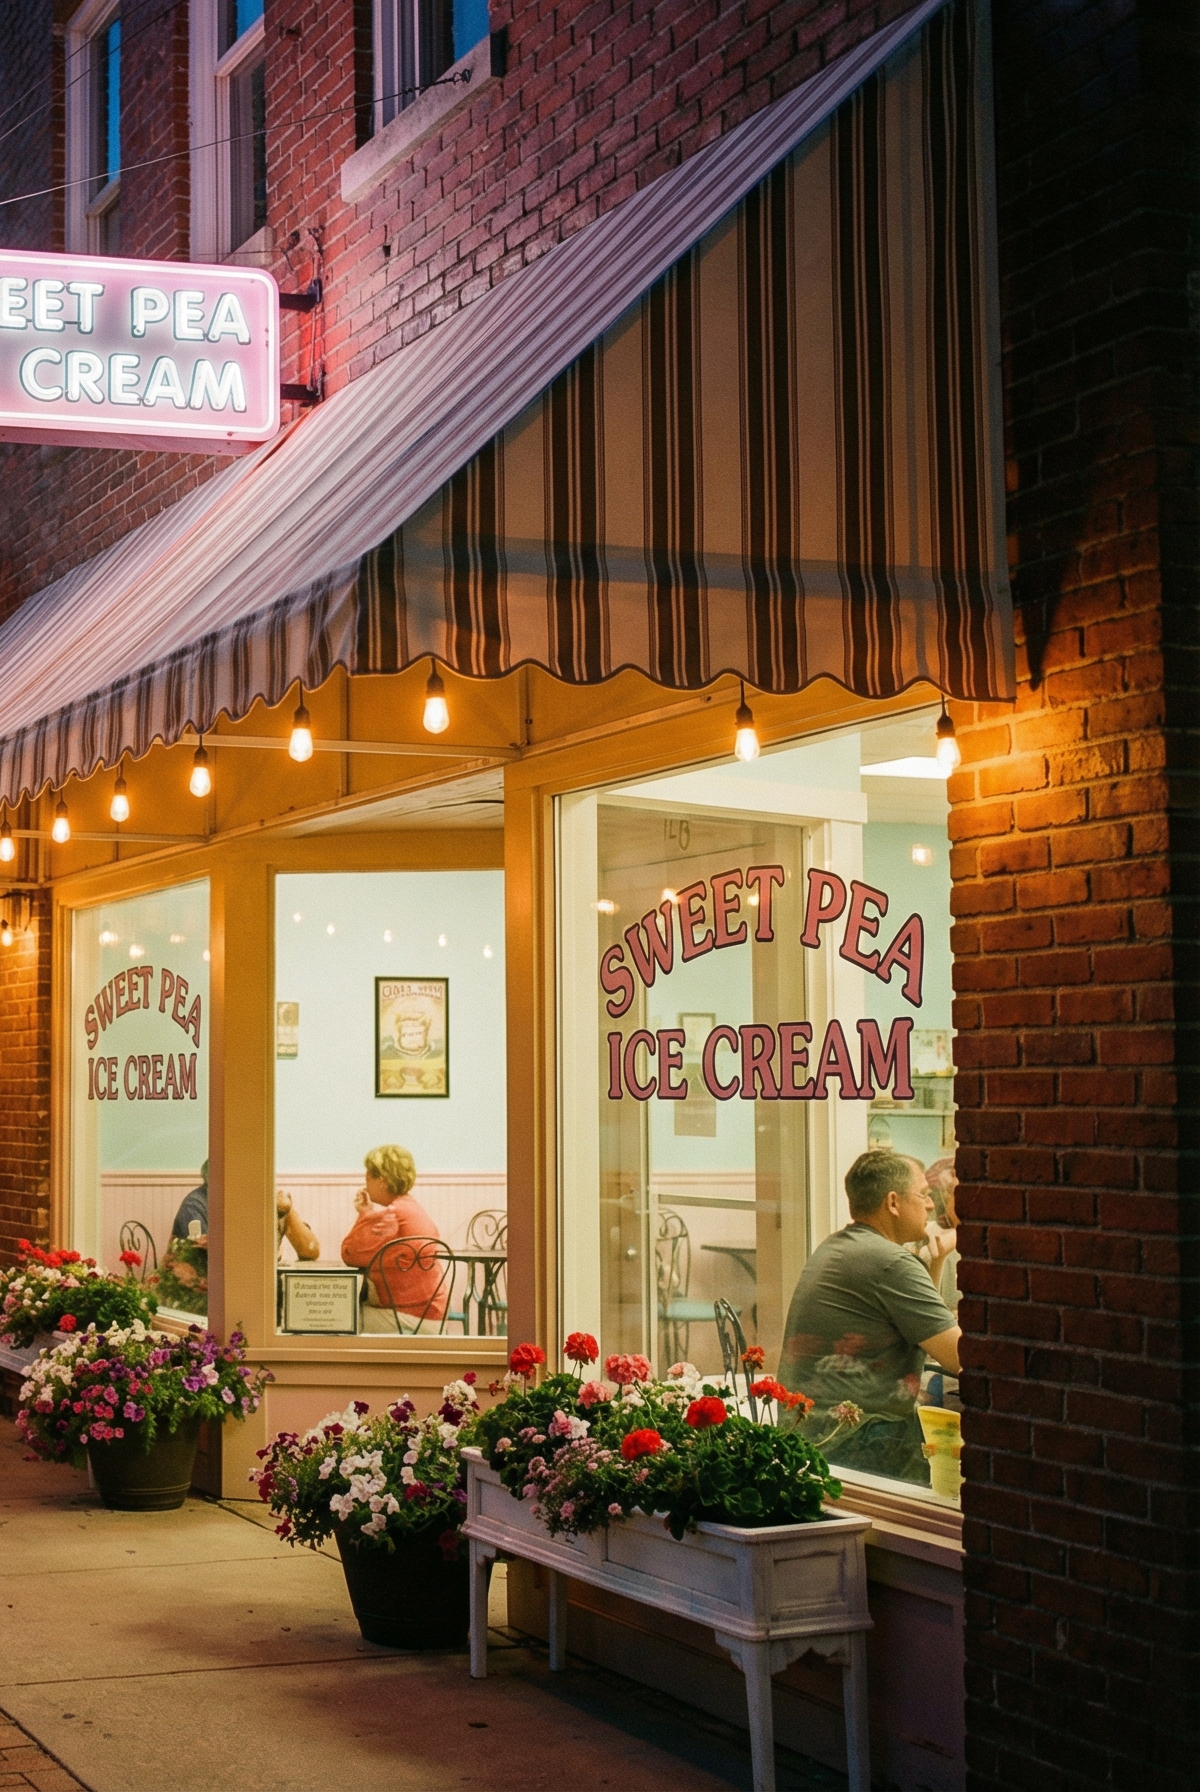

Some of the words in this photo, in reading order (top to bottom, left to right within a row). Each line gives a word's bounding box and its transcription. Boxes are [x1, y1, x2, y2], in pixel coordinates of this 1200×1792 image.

[130, 286, 252, 345] PEA
[19, 347, 247, 412] CREAM
[600, 865, 785, 1018] SWEET
[800, 867, 924, 1008] PEA
[84, 966, 154, 1050] SWEET
[159, 967, 201, 1049] PEA
[87, 1057, 119, 1100] ICE
[124, 1053, 198, 1100] CREAM
[607, 1029, 688, 1101] ICE
[702, 1017, 915, 1101] CREAM
